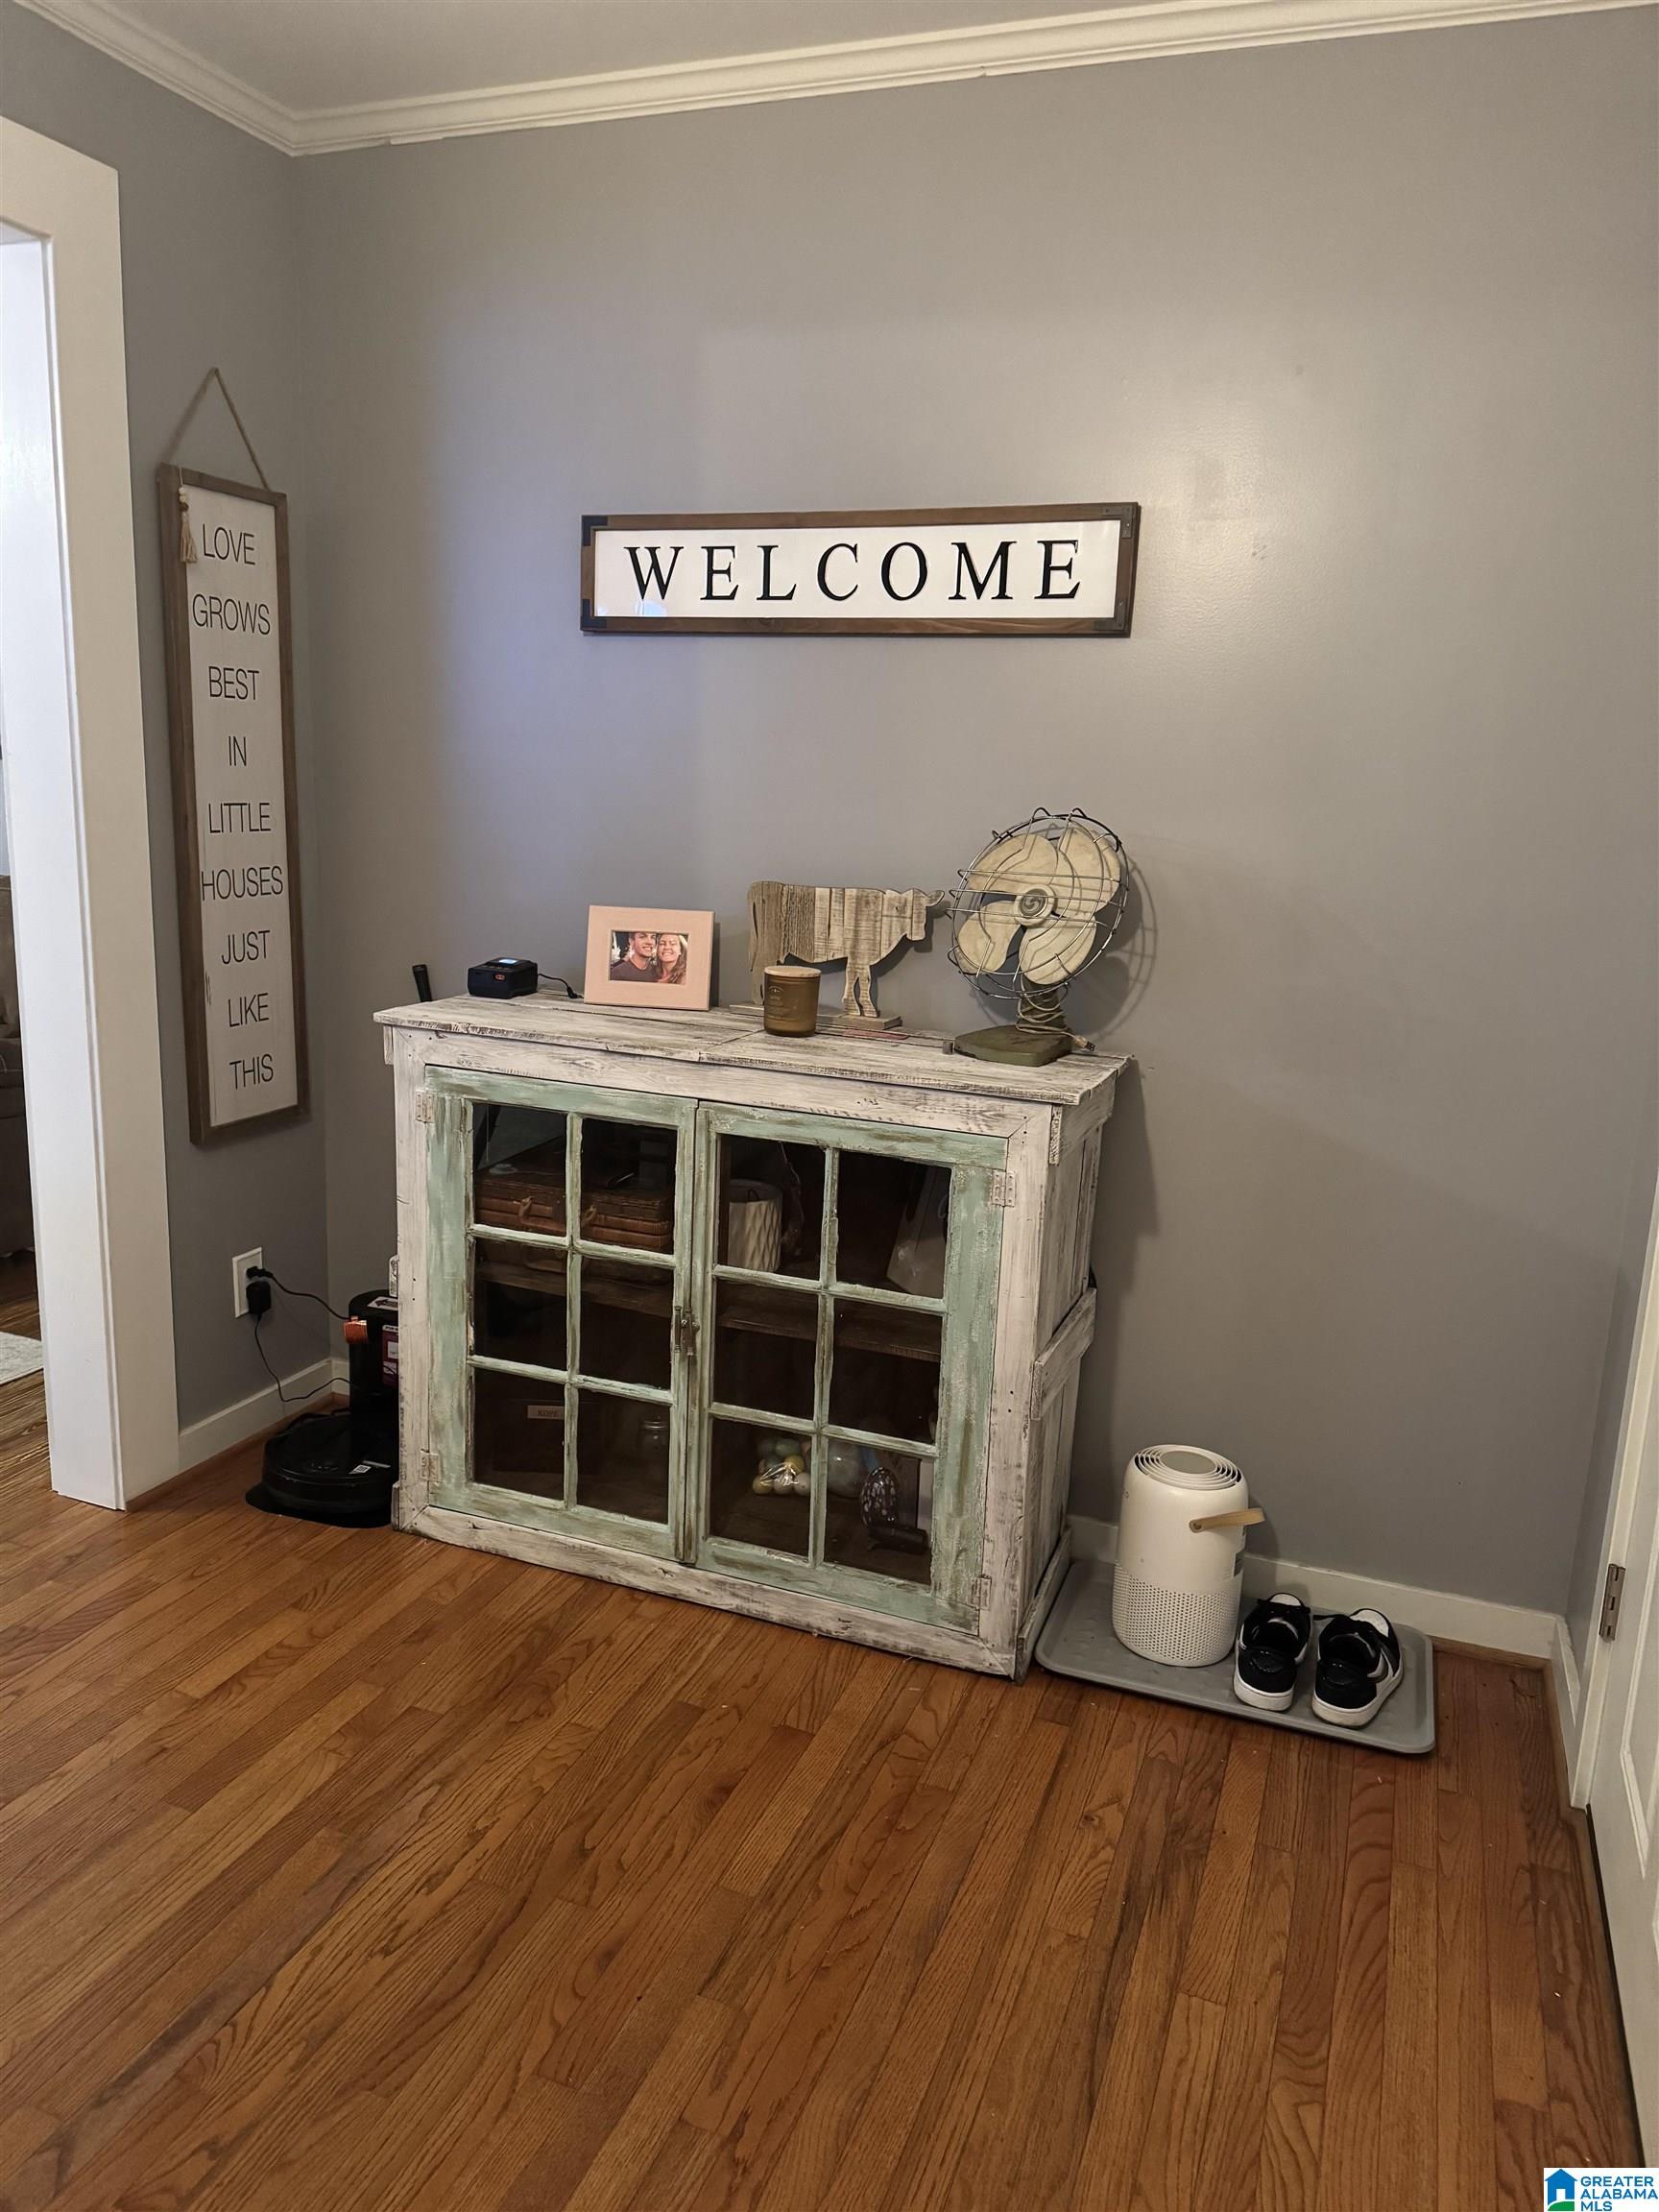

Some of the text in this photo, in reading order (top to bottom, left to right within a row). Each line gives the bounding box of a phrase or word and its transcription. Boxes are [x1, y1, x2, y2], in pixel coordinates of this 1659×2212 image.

[203, 523, 256, 565] LOVE
[623, 539, 1082, 602] WELCOME
[192, 593, 271, 636] GROWS
[208, 665, 260, 701] BEST
[228, 735, 247, 767] IN
[208, 802, 272, 833] LITTLE
[201, 865, 284, 901] HOUSES
[221, 929, 271, 965] JUST
[228, 992, 270, 1027] LIKE
[228, 1053, 275, 1090] THIS
